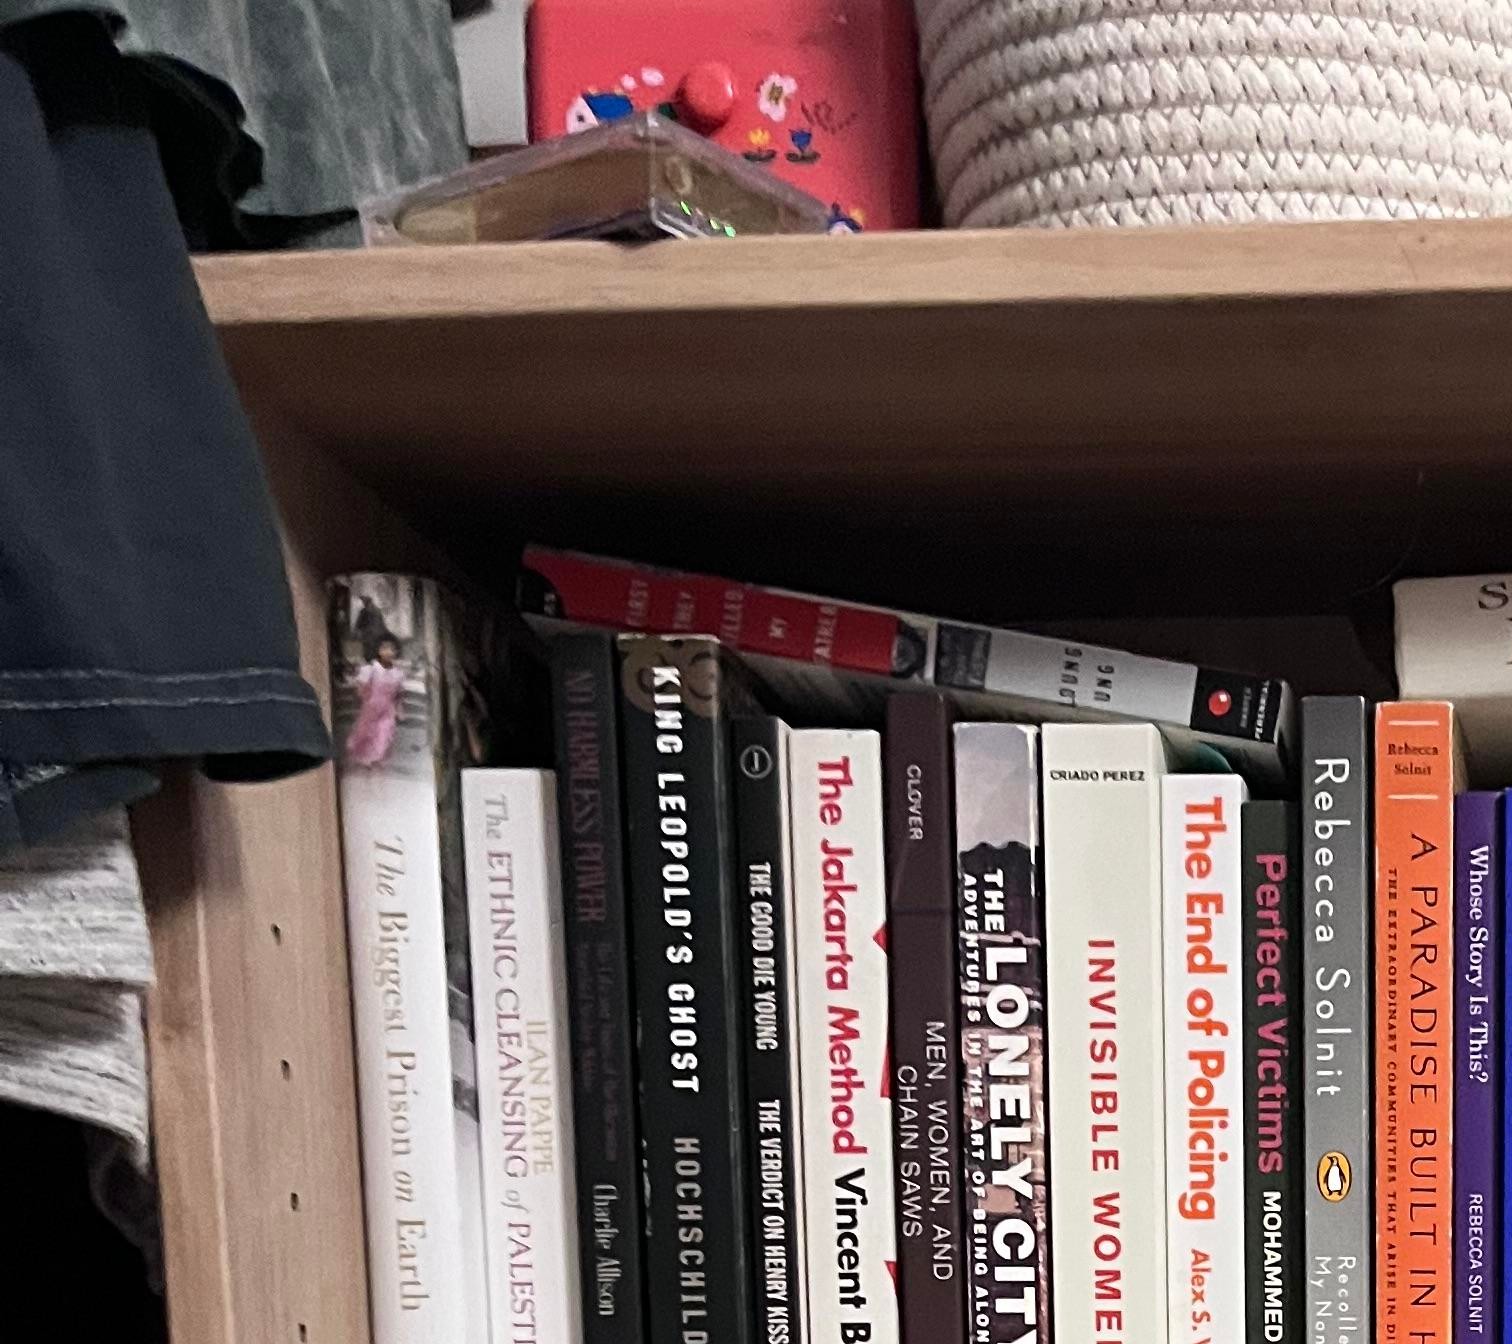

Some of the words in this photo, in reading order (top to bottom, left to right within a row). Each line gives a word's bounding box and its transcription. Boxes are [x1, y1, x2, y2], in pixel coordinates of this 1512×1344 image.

[652, 666, 683, 754] KING
[817, 756, 854, 826] The
[906, 764, 924, 841] CLOVER
[1050, 770, 1100, 781] CRIADO
[1103, 770, 1145, 782] PEREZ
[658, 773, 694, 965] LEOPOLD'S
[1184, 797, 1227, 880] The
[1314, 757, 1349, 943] Rebecca
[1410, 832, 1438, 860] A
[821, 839, 857, 992] Jakarta
[1187, 898, 1228, 975] End
[1254, 853, 1288, 1005] Perfect
[668, 982, 699, 1093] GHOST
[1186, 990, 1228, 1050] of
[1315, 967, 1353, 1097] Solnit
[1410, 886, 1440, 1106] PARADISE
[827, 1006, 868, 1155] Method
[985, 947, 1033, 1199] LONELY
[1088, 939, 1121, 1172] INVISIBLE
[1254, 1016, 1290, 1173] Victims
[758, 1100, 780, 1129] THE
[897, 1067, 918, 1150] CHAIN
[1177, 1051, 1229, 1220] Policing
[760, 1132, 782, 1211] VERDICT
[900, 1162, 923, 1238] SAWS
[1410, 1129, 1437, 1244] BUILT
[763, 1216, 783, 1238] ON
[763, 1244, 785, 1302] HENRY
[834, 1168, 868, 1310] Vincent
[1263, 1191, 1286, 1342] MOHAMMED
[1411, 1268, 1437, 1307] IN
